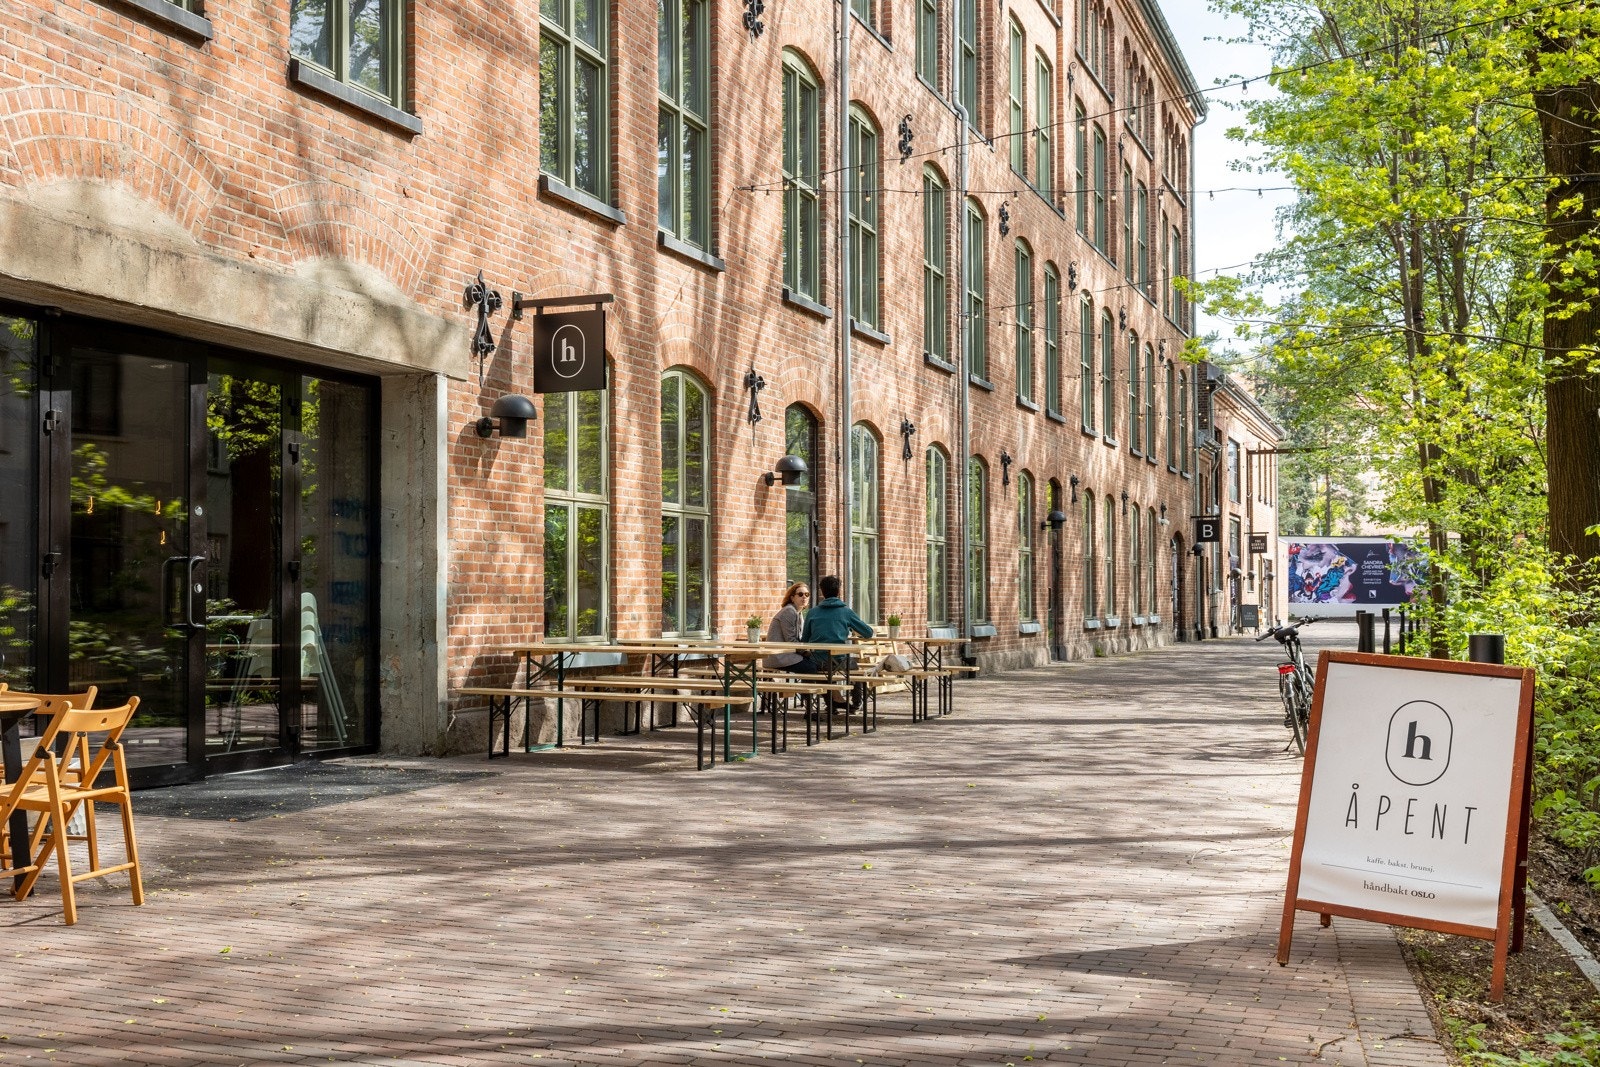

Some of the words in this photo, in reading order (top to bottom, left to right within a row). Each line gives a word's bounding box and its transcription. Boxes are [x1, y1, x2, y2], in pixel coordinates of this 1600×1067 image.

[560, 337, 577, 362] h
[1203, 525, 1213, 538] B
[1401, 720, 1433, 761] h
[1345, 783, 1478, 845] ÅPENT
[1366, 855, 1386, 866] kaffe.
[1387, 859, 1409, 870] bakst.
[1363, 880, 1409, 897] håndbakt
[1410, 889, 1436, 900] OSLO
